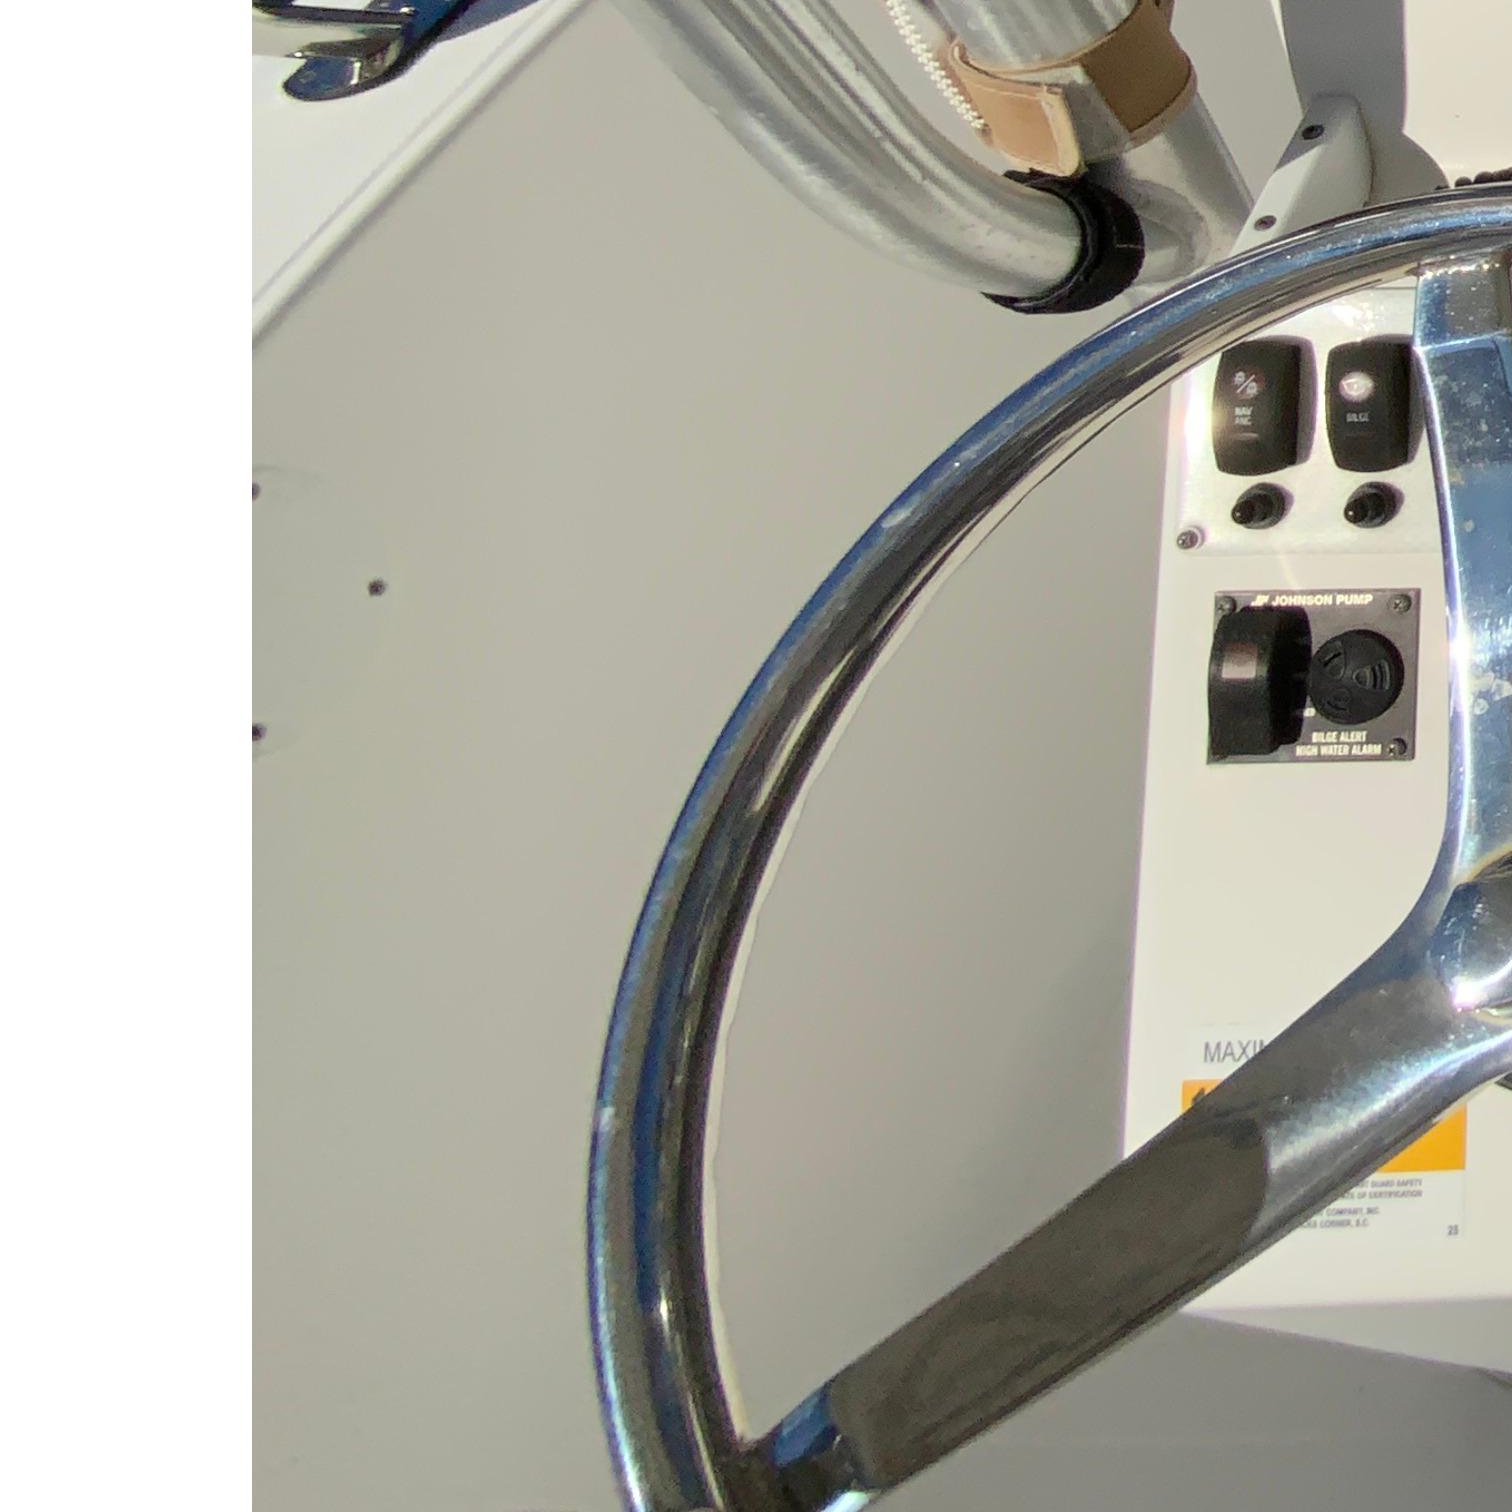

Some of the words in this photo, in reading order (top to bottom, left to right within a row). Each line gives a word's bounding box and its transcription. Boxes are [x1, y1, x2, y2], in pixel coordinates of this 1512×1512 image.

[1272, 594, 1333, 607] JOHNSON
[1336, 593, 1374, 605] PUMP
[1311, 731, 1337, 743] BILGE
[1339, 730, 1368, 742] ALERT
[1295, 745, 1318, 756] HIGH
[1319, 744, 1349, 756] WATER
[1351, 743, 1382, 755] ALARM
